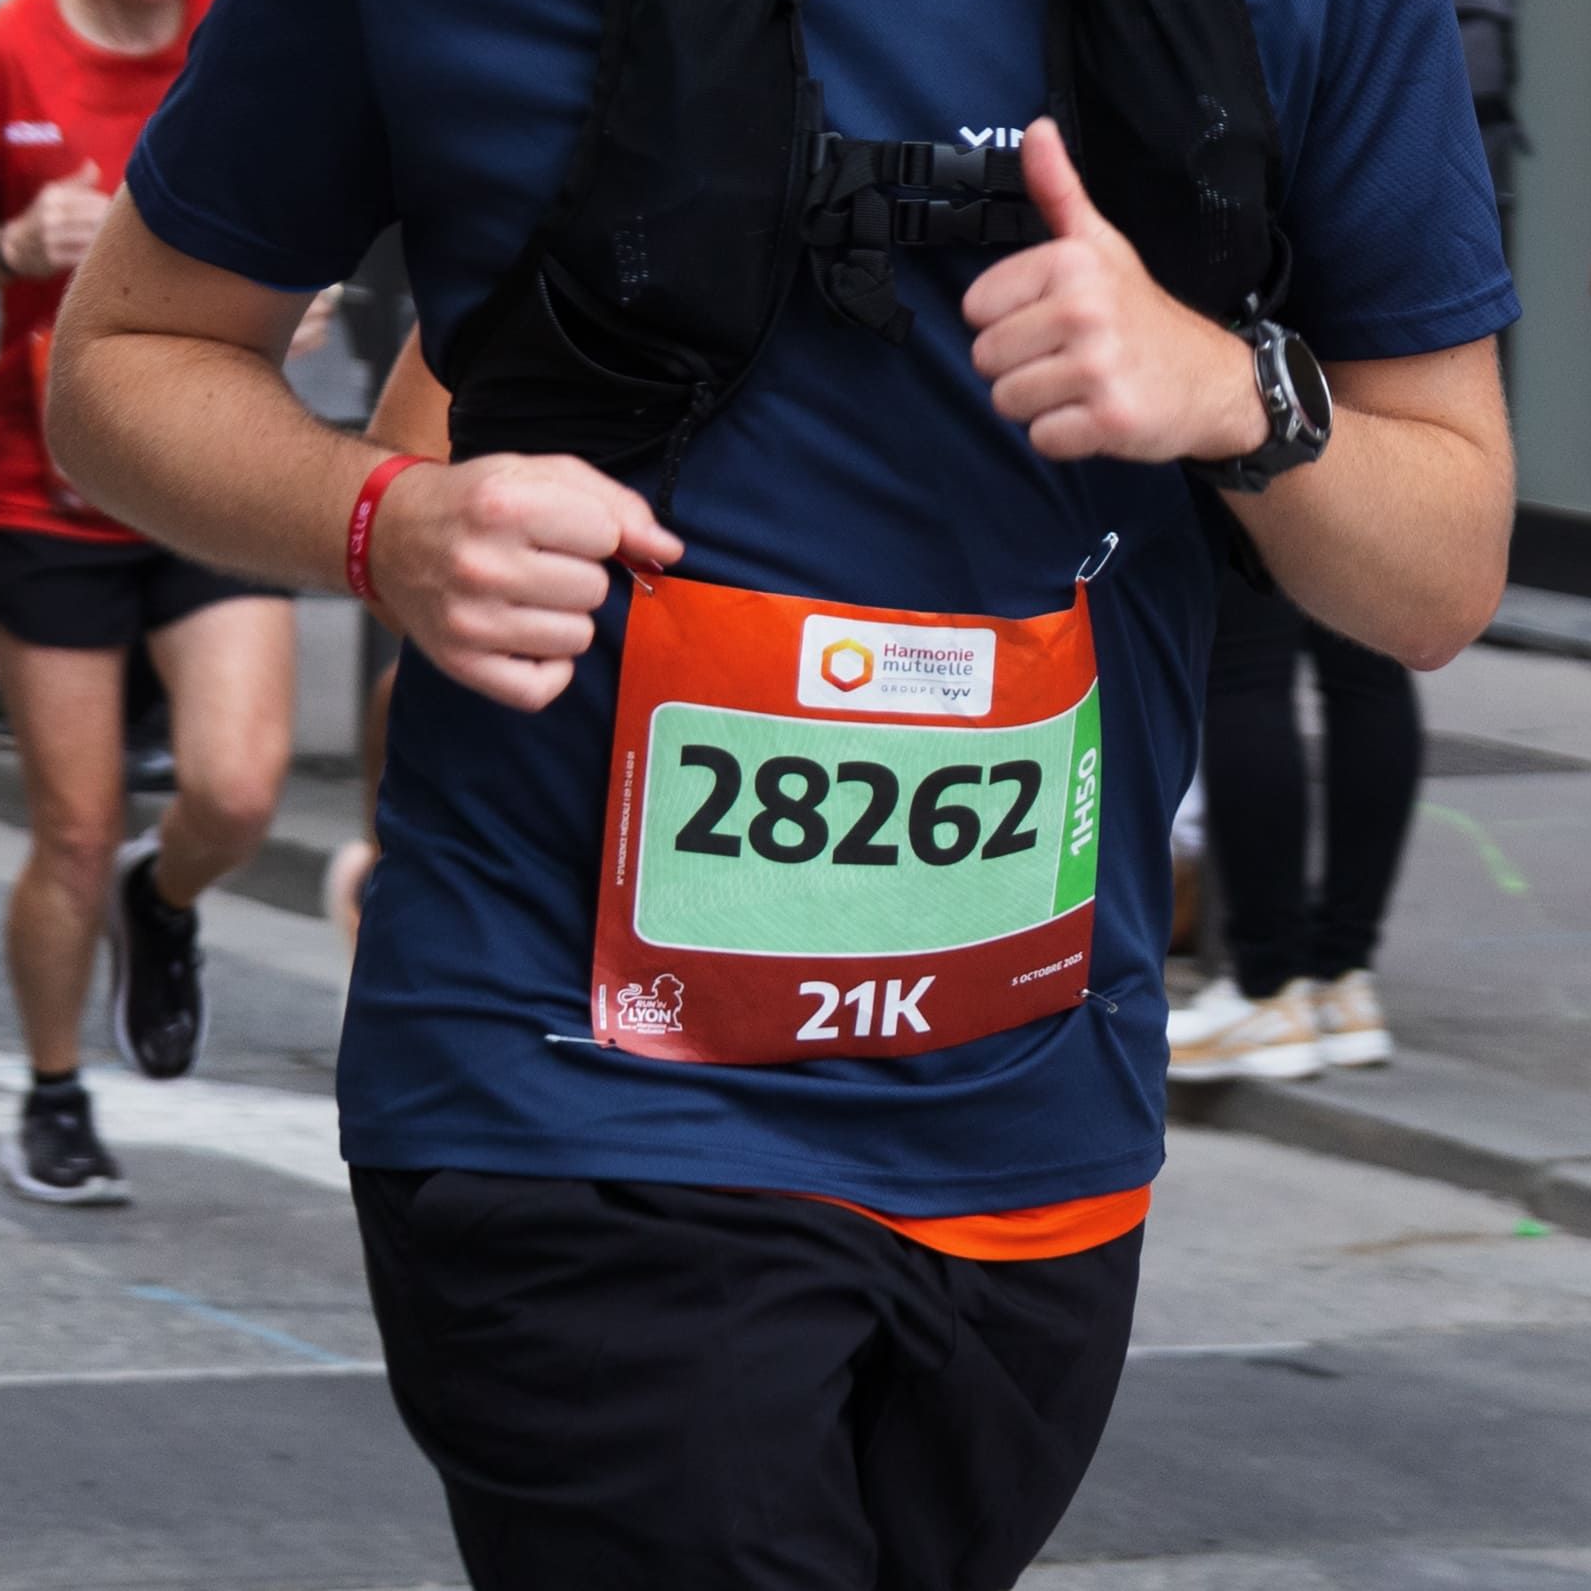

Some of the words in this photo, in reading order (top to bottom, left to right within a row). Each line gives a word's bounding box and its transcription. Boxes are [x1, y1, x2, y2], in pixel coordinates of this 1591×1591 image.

[883, 643, 974, 662] Harmonie
[882, 659, 973, 676] mutuelle
[881, 683, 935, 695] GROUPE
[941, 687, 971, 701] vyv
[675, 744, 1043, 866] 28262
[1070, 746, 1097, 857] 1H50
[1011, 976, 1019, 986] 5
[1019, 960, 1063, 984] OCTOBRE
[1063, 951, 1084, 968] 2025
[628, 1007, 672, 1024] LYON
[796, 976, 936, 1041] 21K
